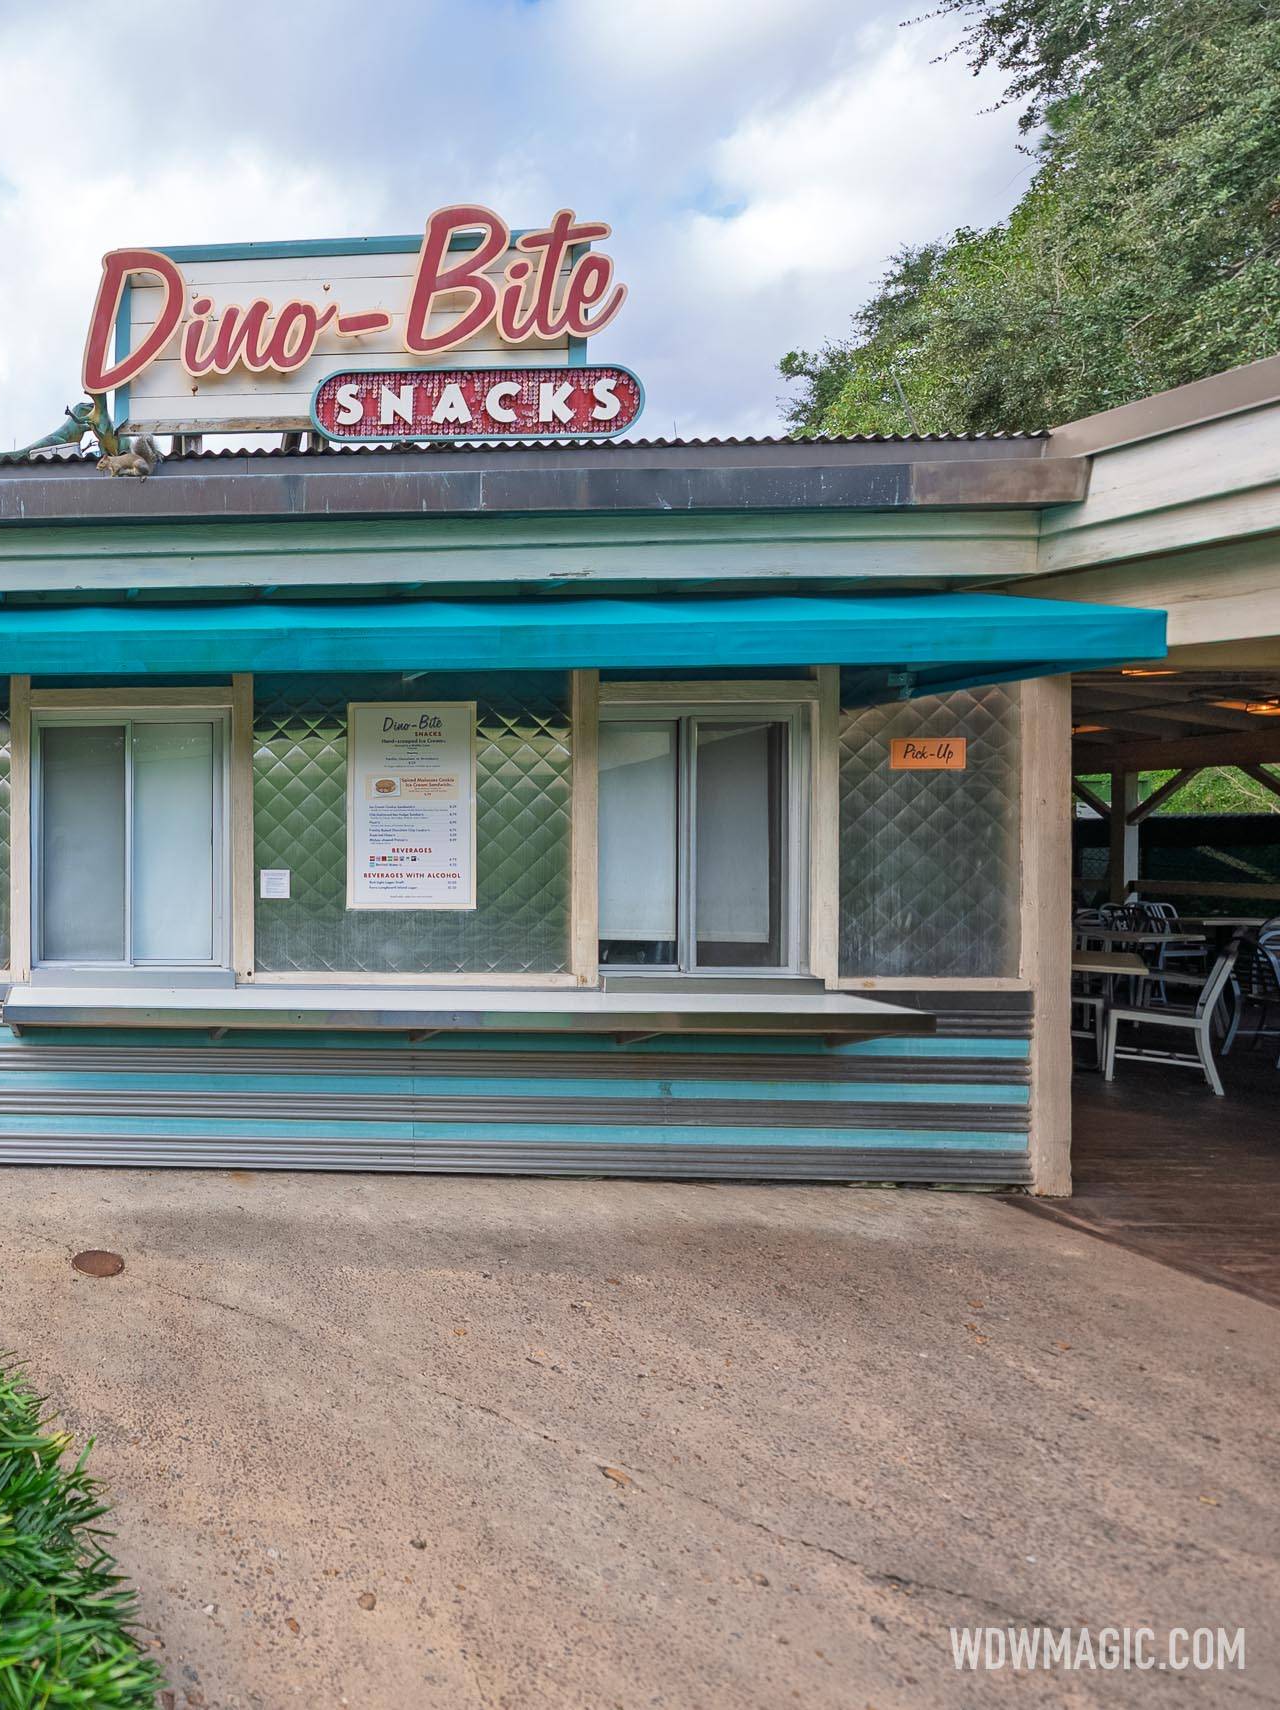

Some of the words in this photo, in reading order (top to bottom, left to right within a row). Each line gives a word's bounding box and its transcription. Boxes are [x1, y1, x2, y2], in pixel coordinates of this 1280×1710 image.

[82, 204, 627, 393] Dino-Bite
[335, 378, 622, 425] SNACKS
[383, 714, 443, 732] Dino-Bite
[903, 743, 953, 764] Pick-Up
